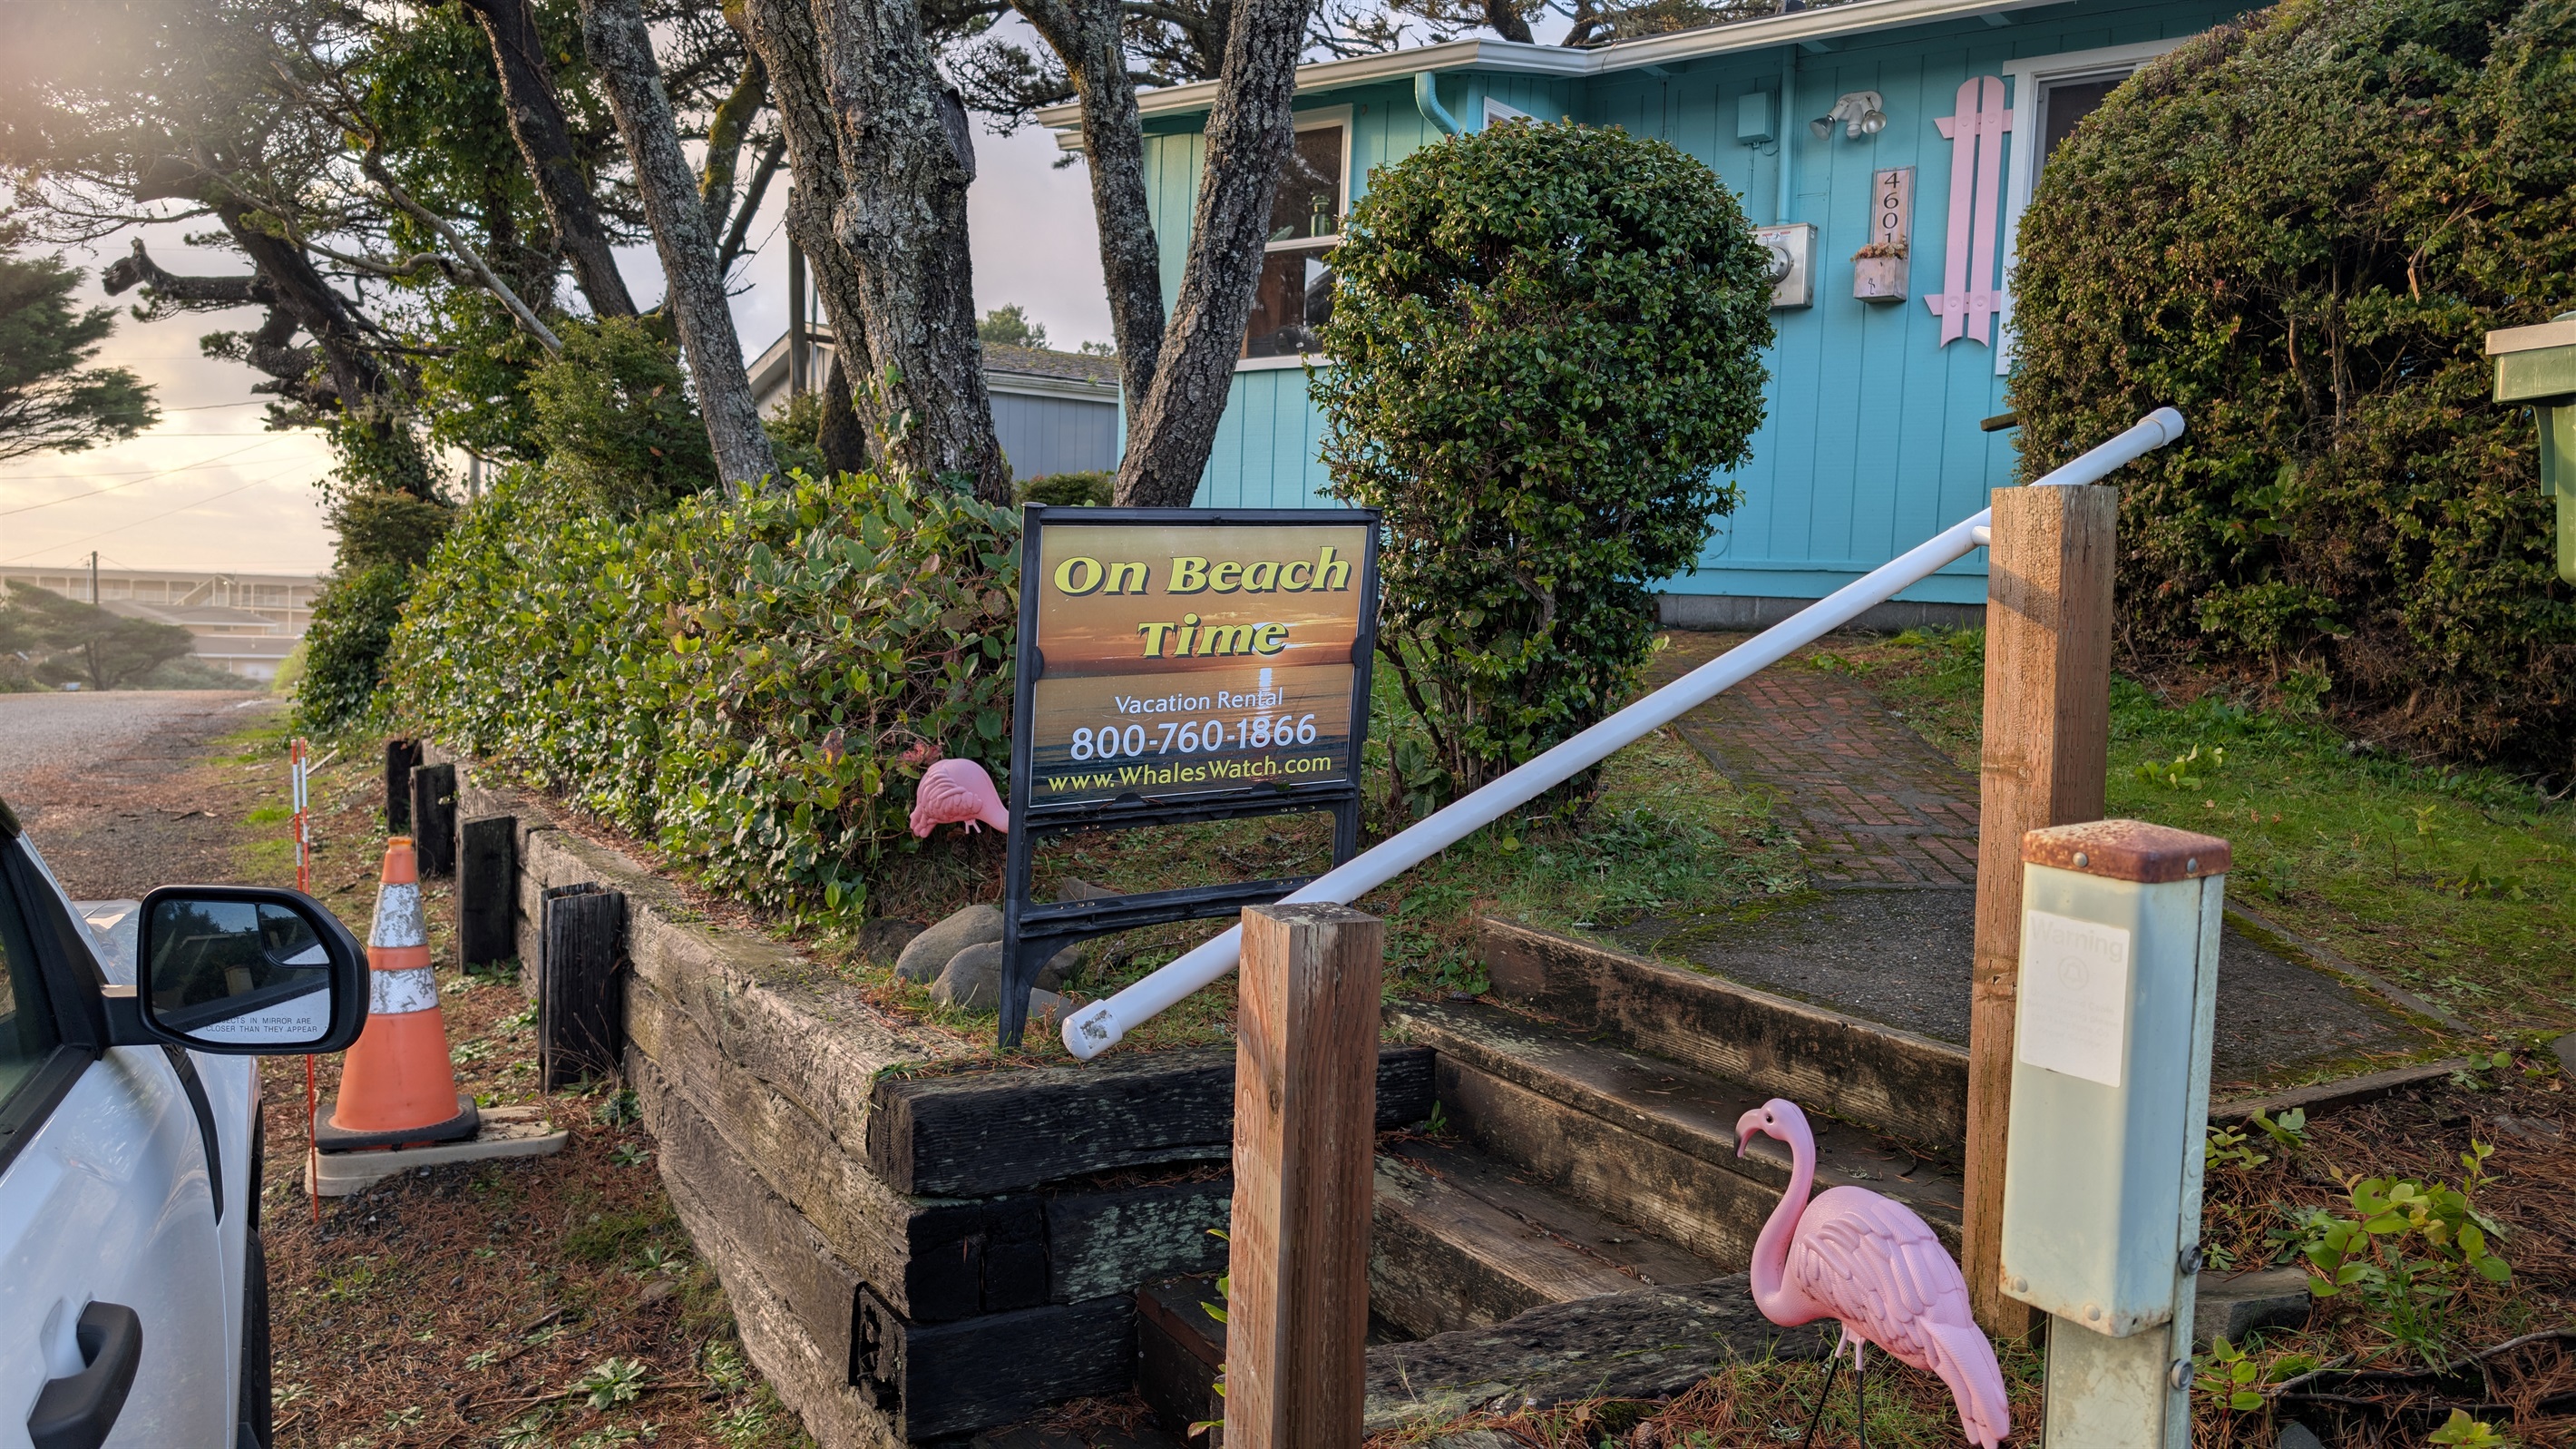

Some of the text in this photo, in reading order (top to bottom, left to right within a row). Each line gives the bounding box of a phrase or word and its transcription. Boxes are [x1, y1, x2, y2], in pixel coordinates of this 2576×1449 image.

[1053, 546, 1352, 596] On Beach
[1137, 612, 1289, 659] Time
[1114, 687, 1283, 714] Vacation Rental
[1069, 713, 1317, 761] 800-760-1866
[1048, 755, 1332, 792] www.WhalesWatch.com
[2030, 916, 2123, 964] Warning
